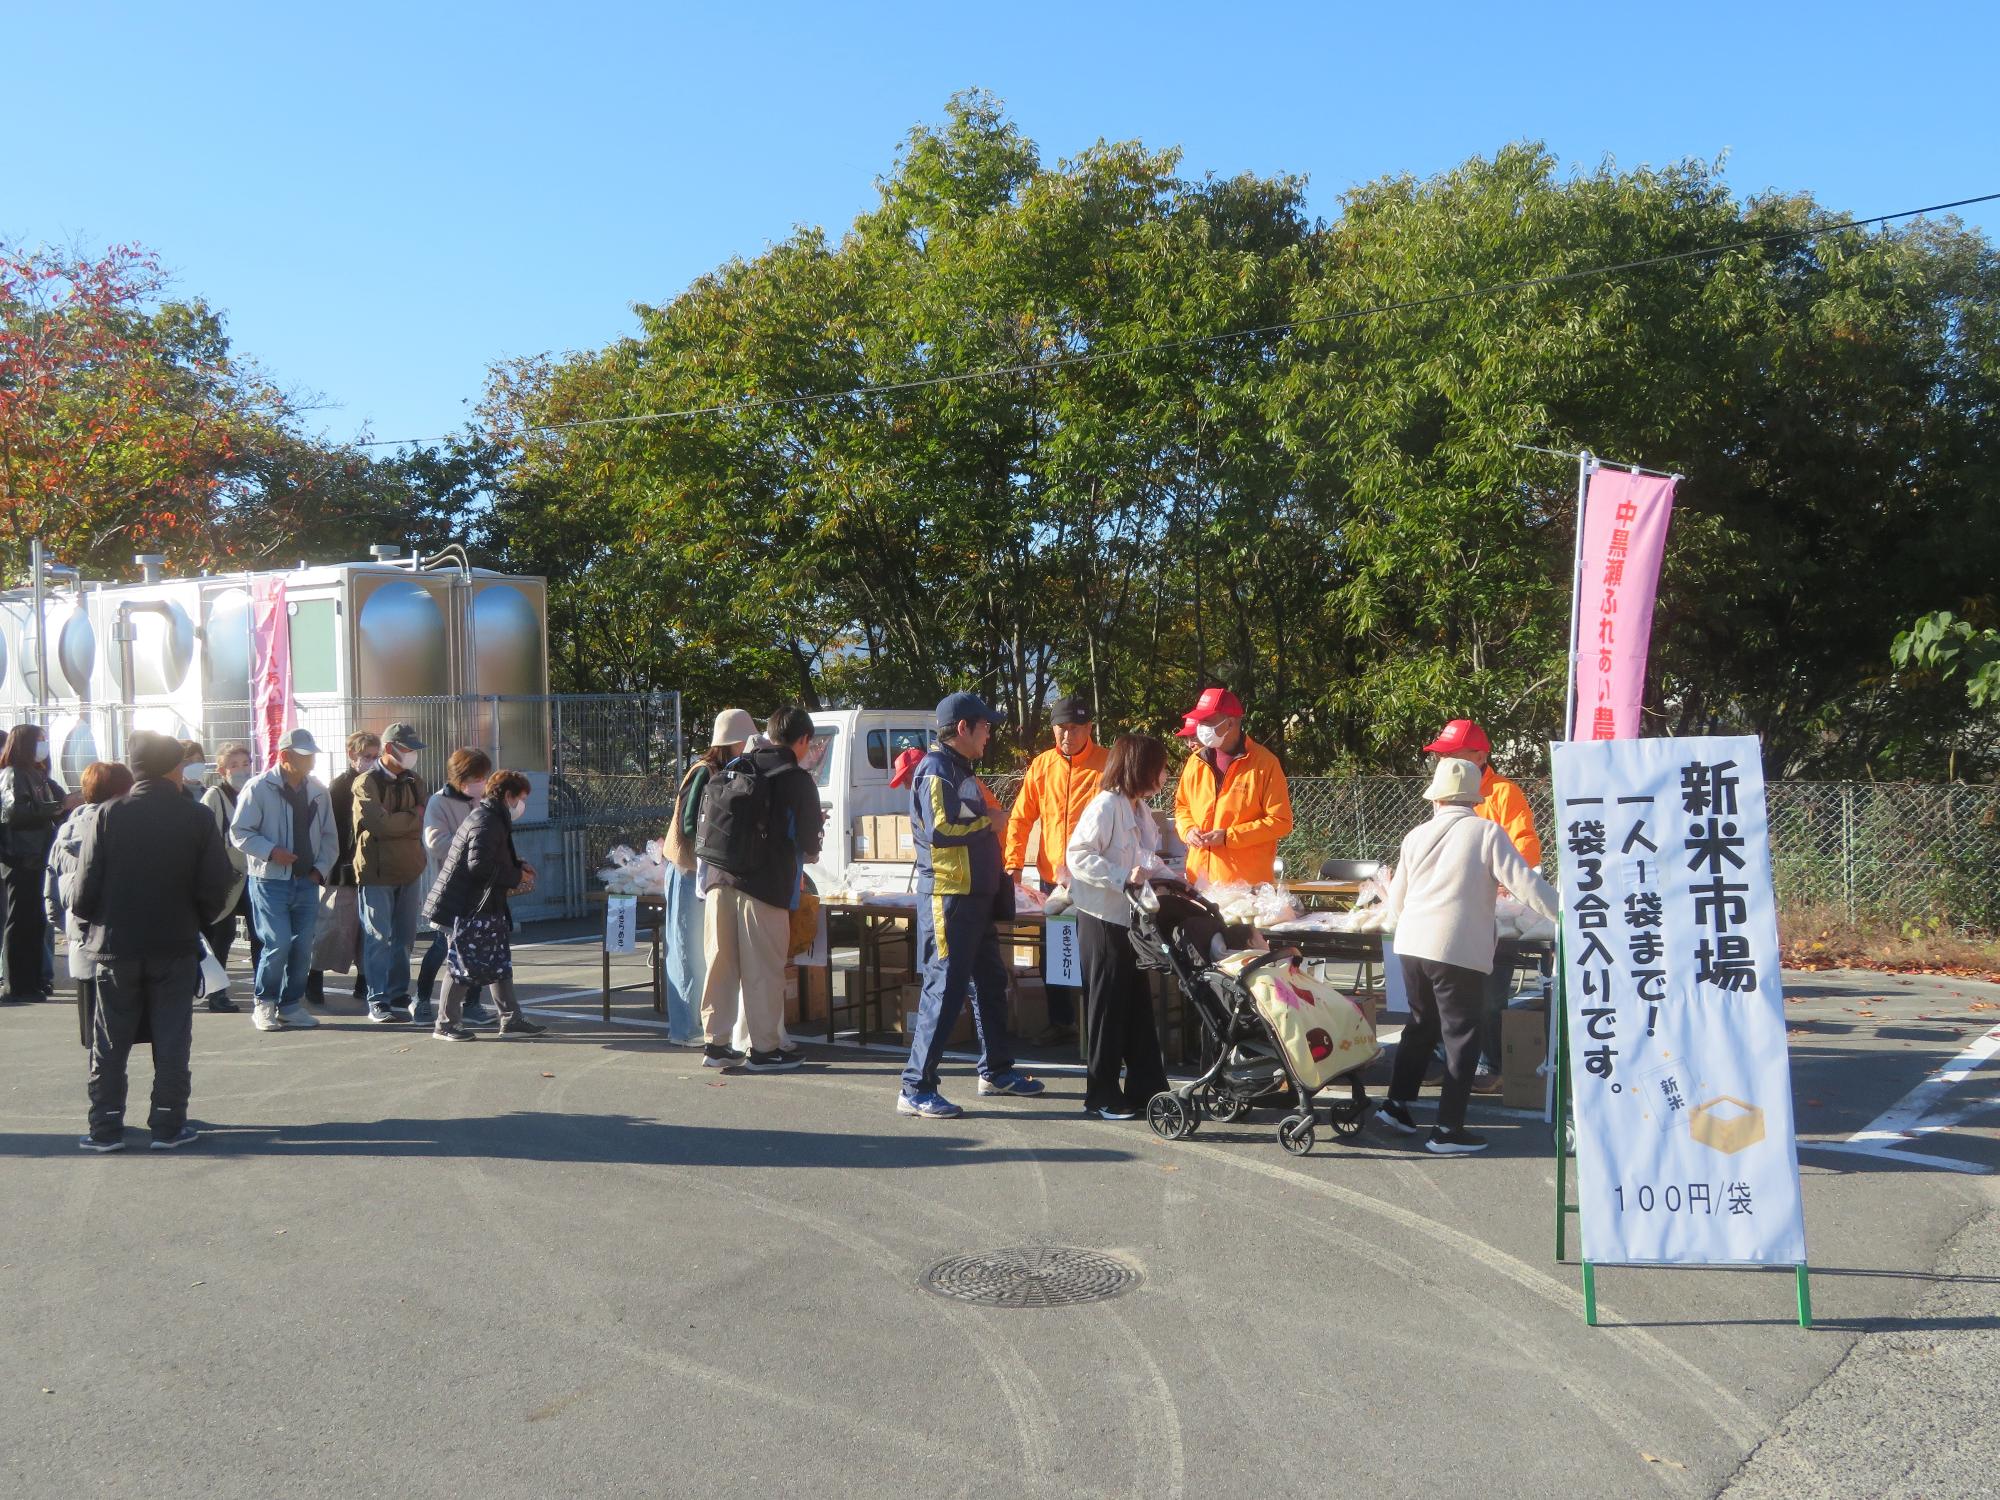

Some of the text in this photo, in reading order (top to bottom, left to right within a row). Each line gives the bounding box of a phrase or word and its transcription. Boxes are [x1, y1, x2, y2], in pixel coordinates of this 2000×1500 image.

[1681, 760, 1757, 993] 新米市場
[1062, 925, 1073, 980] あきさかり
[1566, 797, 1622, 1093] 一袋3合入りです。
[1660, 1076, 1686, 1112] 新米
[1614, 1181, 1754, 1216] 100円/袋
